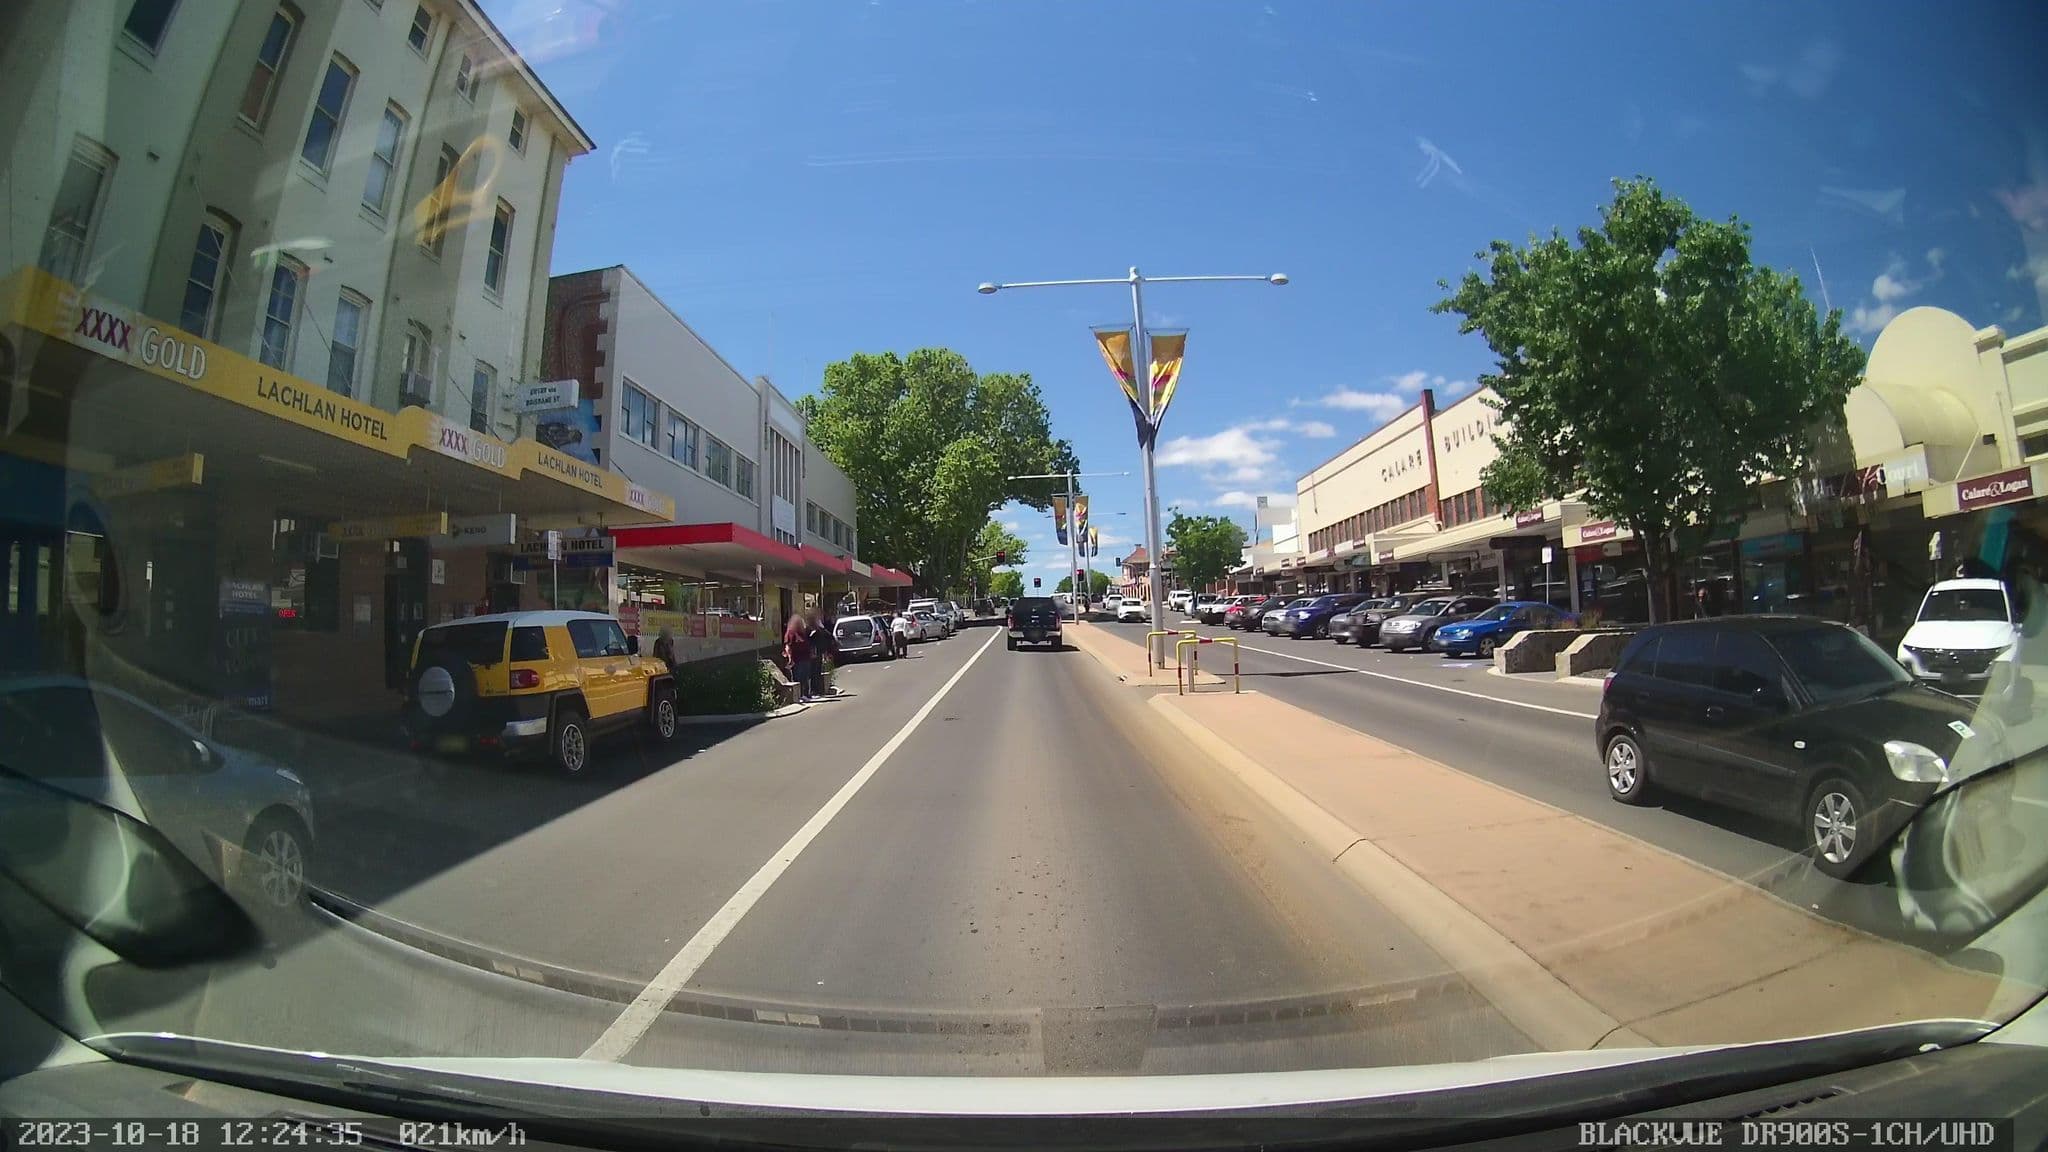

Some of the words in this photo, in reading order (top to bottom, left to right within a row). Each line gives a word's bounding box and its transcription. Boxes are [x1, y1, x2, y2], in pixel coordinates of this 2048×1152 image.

[75, 307, 132, 353] XXXX
[140, 326, 207, 380] GOLD
[257, 376, 336, 423] LACHLAN
[340, 407, 388, 441] HOTEL
[439, 428, 467, 455] XXXX
[473, 439, 505, 468] GOLD
[1444, 414, 1493, 453] BUILDI
[538, 451, 578, 478] LACHLAN
[579, 466, 603, 489] HOTEL
[630, 489, 645, 506] XXXX
[464, 526, 486, 535] KENO
[520, 539, 568, 554] LACHN
[571, 539, 604, 550] HOTEL
